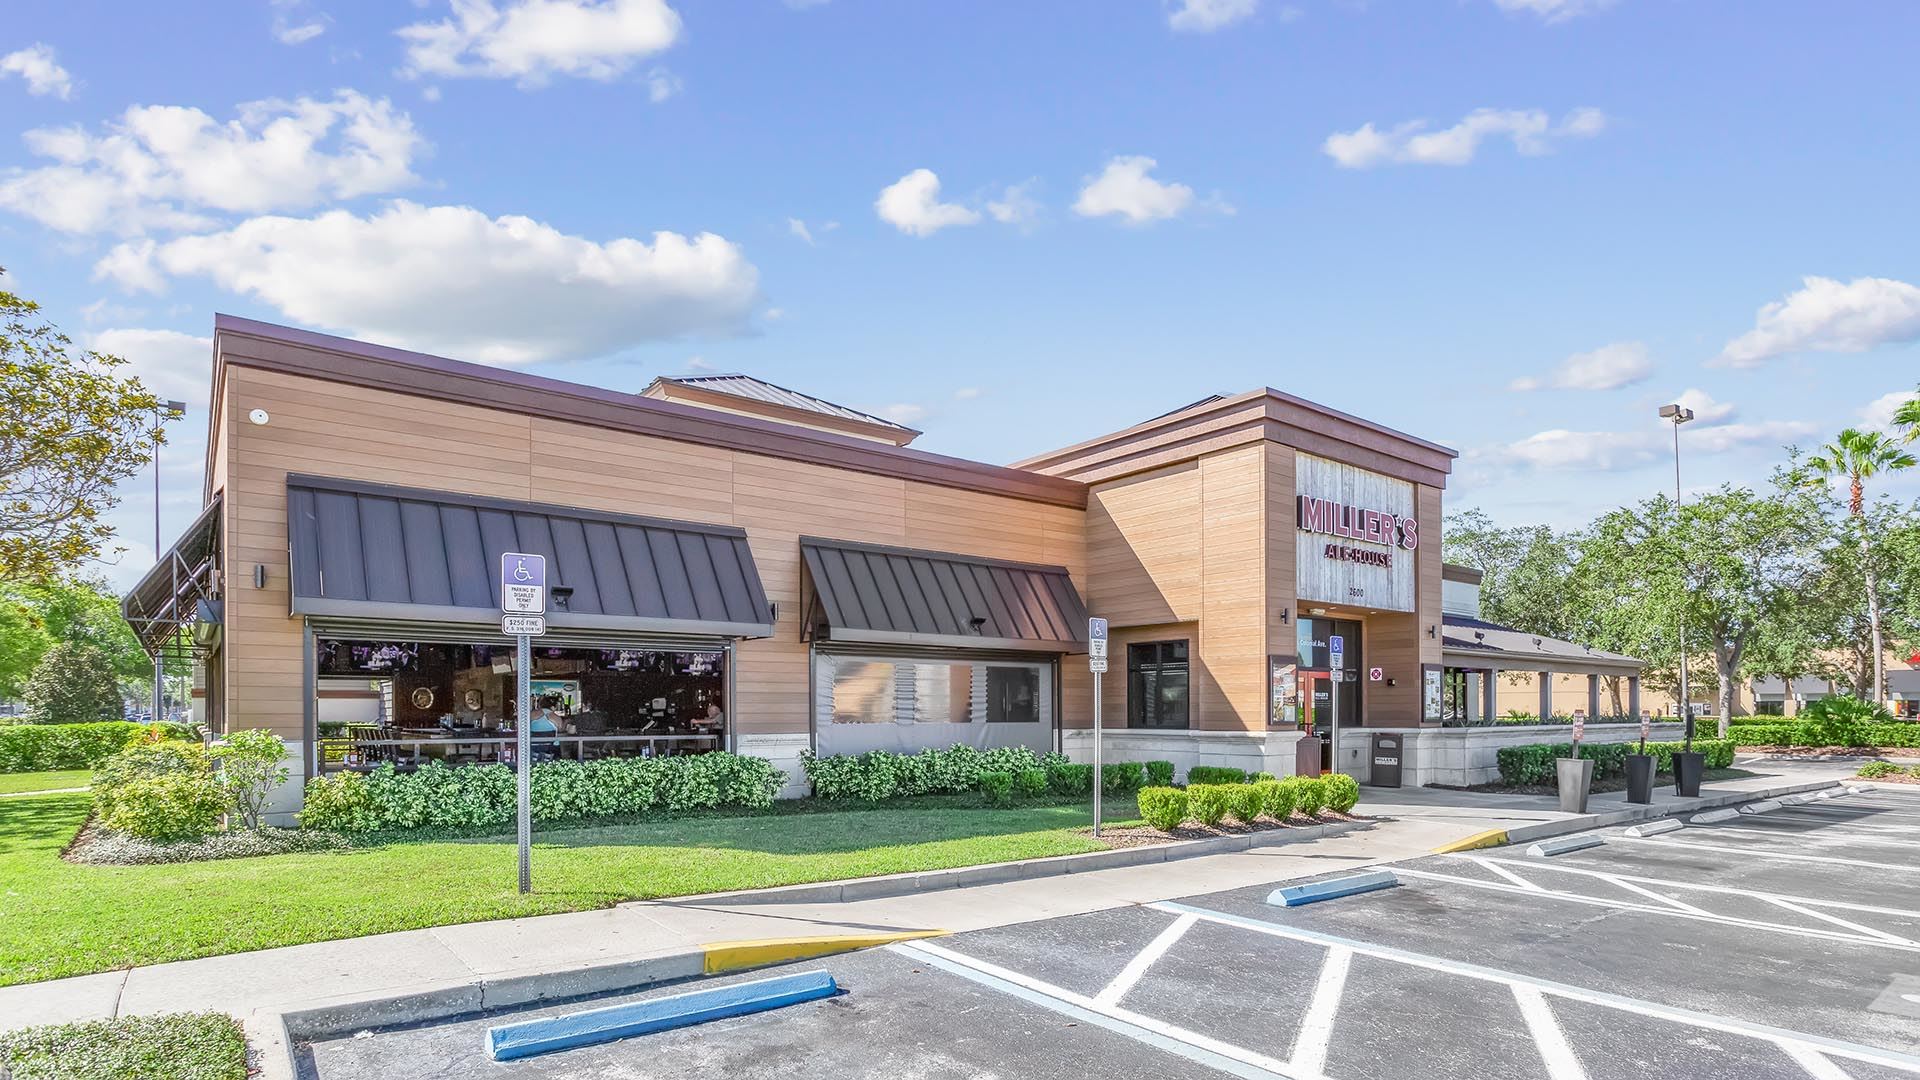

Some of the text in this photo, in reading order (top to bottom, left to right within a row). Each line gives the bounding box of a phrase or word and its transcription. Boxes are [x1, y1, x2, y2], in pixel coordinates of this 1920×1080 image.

[1300, 495, 1418, 550] MILLER'S
[1353, 549, 1392, 568] HOUSE
[1349, 587, 1364, 598] 2600
